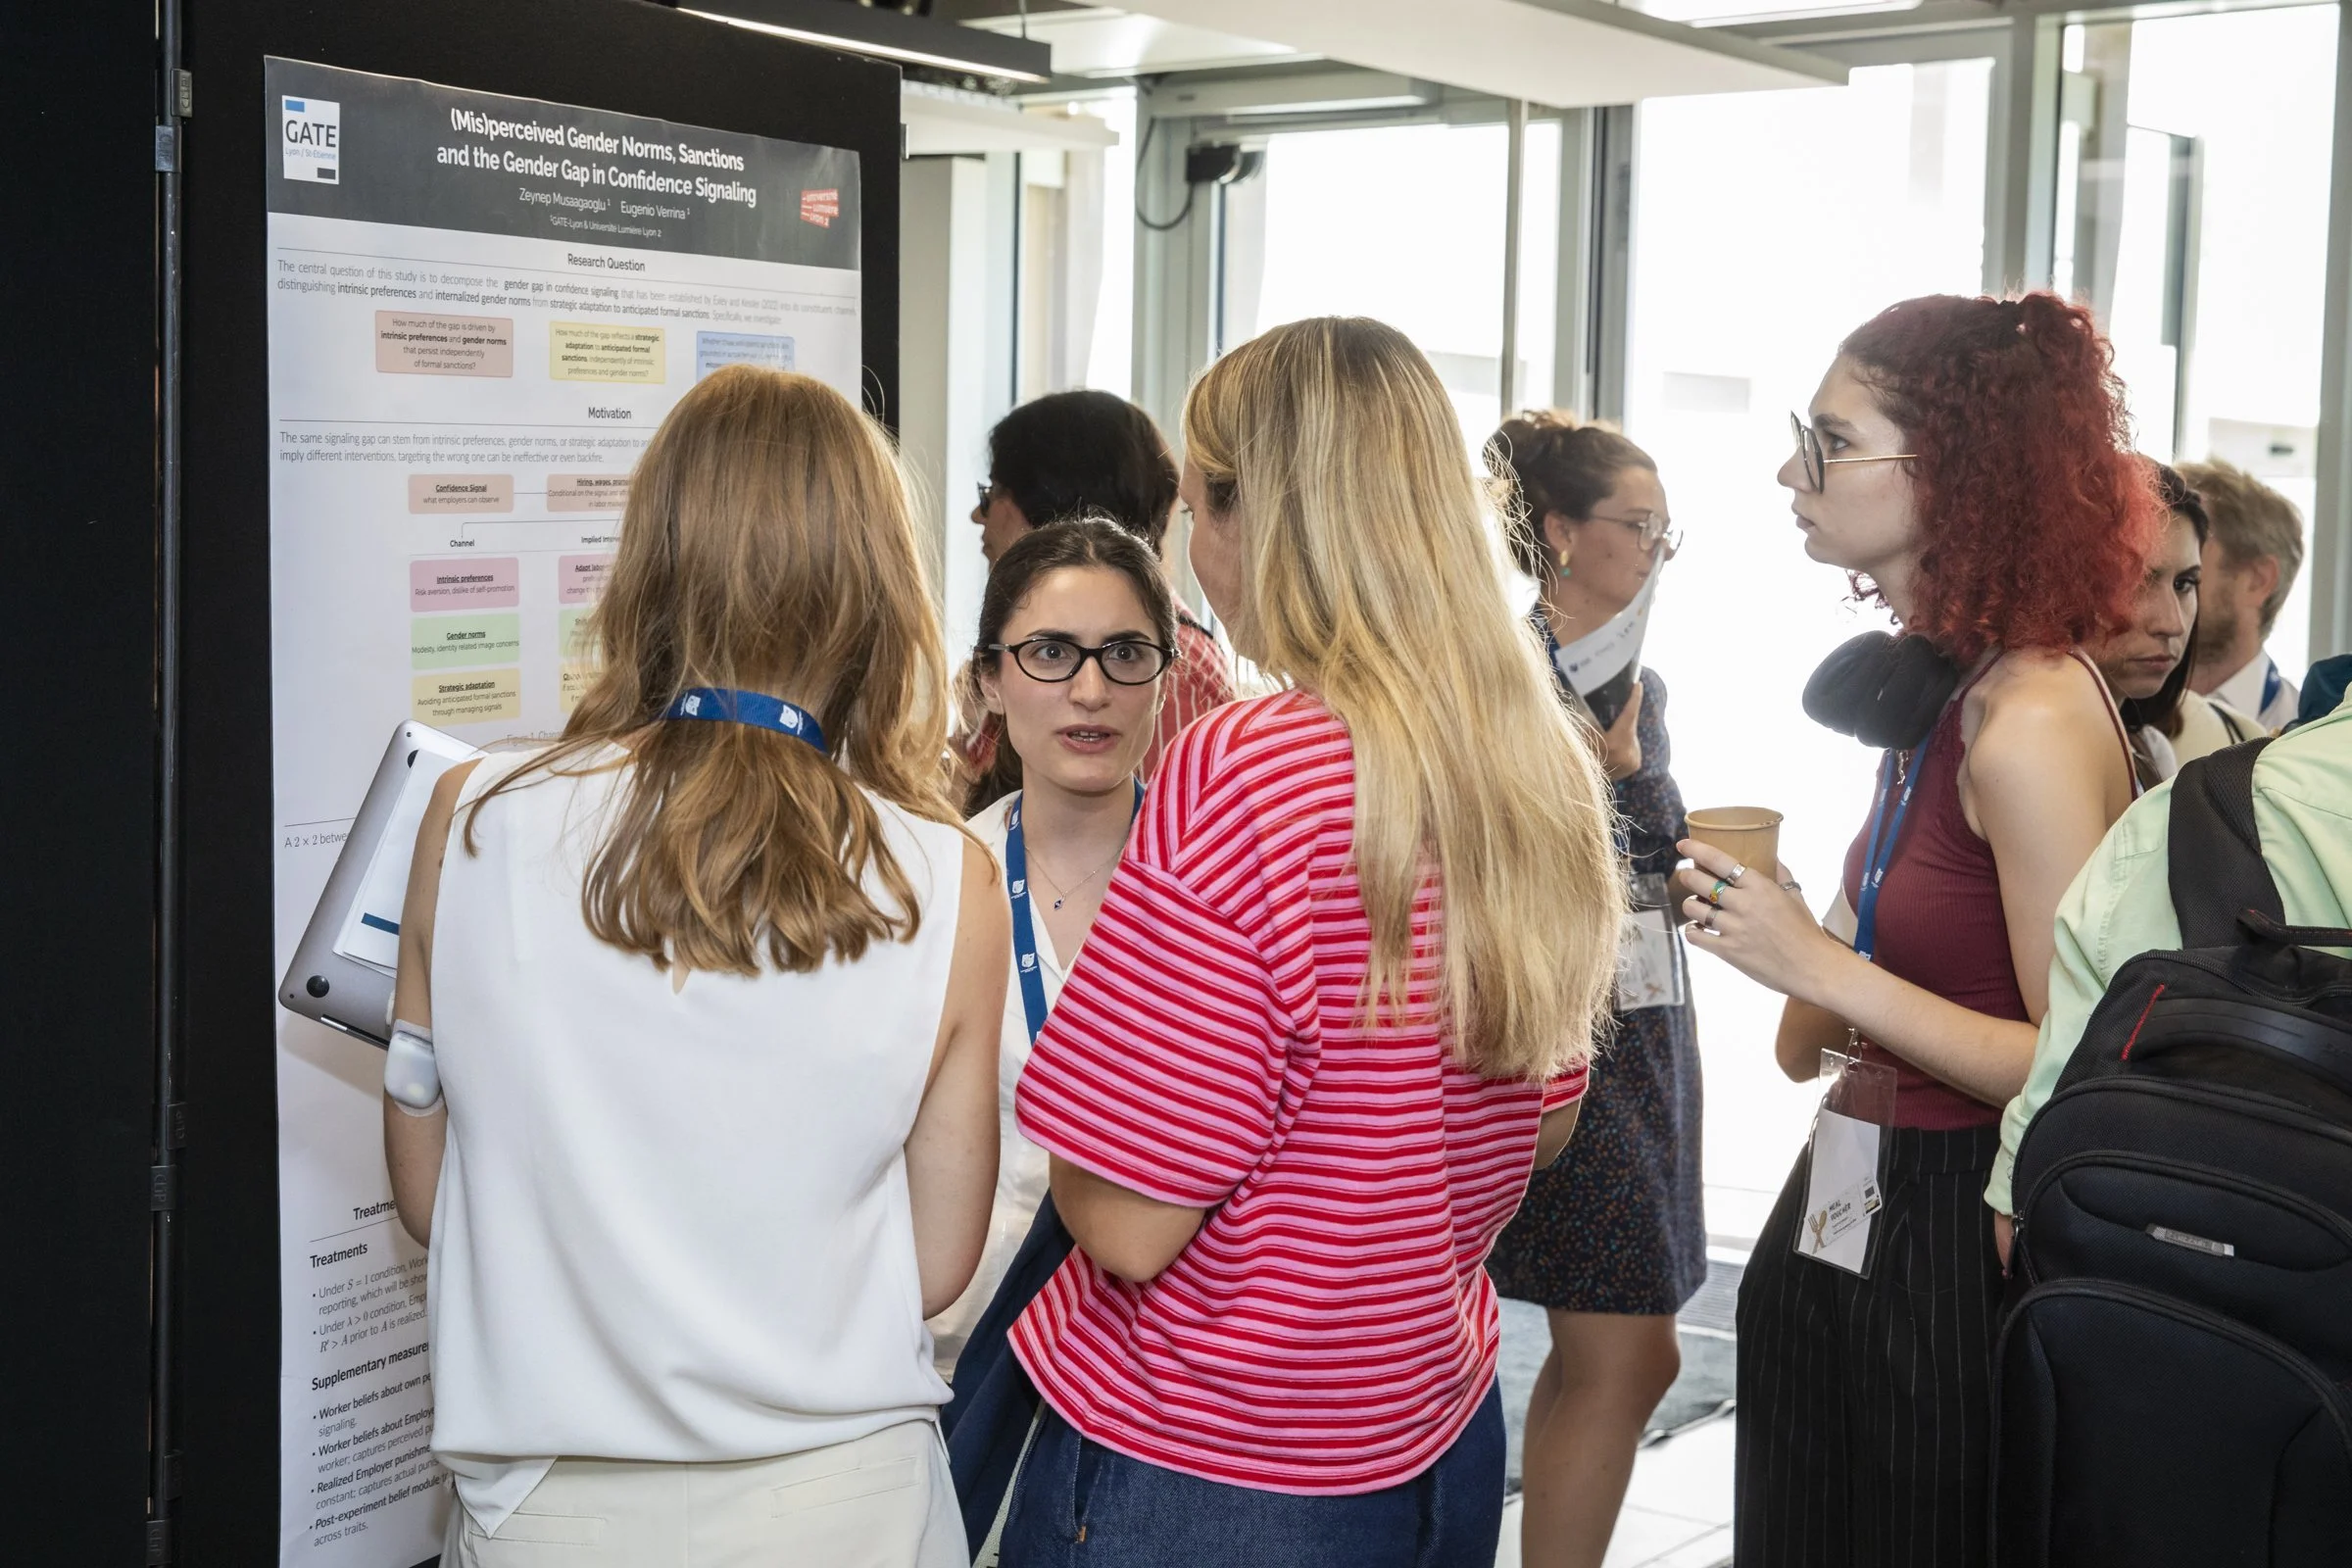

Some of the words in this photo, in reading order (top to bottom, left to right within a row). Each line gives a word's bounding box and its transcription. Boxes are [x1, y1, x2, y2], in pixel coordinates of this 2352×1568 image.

[285, 120, 336, 148] GATE
[451, 108, 564, 145] (Mis)perceived
[567, 126, 617, 154] Gender
[622, 135, 676, 164] Norms,
[679, 144, 744, 171] Sanctions
[437, 145, 469, 167] and
[473, 149, 499, 170] the
[504, 151, 557, 177] Gender
[562, 160, 589, 186] Gap
[593, 164, 605, 184] in
[609, 167, 692, 195] Confidence
[696, 177, 757, 208] Signaling
[519, 188, 551, 206] Zeynep
[621, 201, 655, 218] Eugenio
[656, 206, 685, 220] Verrina
[568, 254, 605, 268] Research
[608, 257, 645, 270] Question
[277, 260, 294, 271] The
[299, 263, 325, 274] central
[330, 265, 364, 277] question
[378, 268, 391, 278] this
[395, 269, 416, 283] study
[441, 271, 482, 287] decompose
[486, 275, 498, 286] the
[505, 277, 528, 290] gender
[532, 281, 543, 293] gap
[277, 278, 335, 296] distinguishing
[338, 283, 368, 295] intrinsic
[370, 286, 416, 299] preferences
[418, 289, 432, 299] and
[435, 289, 479, 303] internalized
[481, 293, 507, 306] gender
[509, 297, 530, 306] norms
[532, 296, 548, 307] from
[551, 299, 577, 312] strategic
[579, 301, 612, 314] adaptation
[622, 304, 659, 317] anticipated
[661, 306, 680, 317] formal
[381, 331, 407, 340] intrinsic
[409, 333, 447, 343] preferences
[463, 336, 484, 345] gender
[418, 347, 438, 356] persist
[440, 348, 484, 359] independently
[589, 407, 631, 418] Motivation
[280, 432, 297, 443] The
[325, 433, 360, 446] signaling
[362, 436, 375, 447] gap
[393, 434, 411, 444] stem
[413, 434, 430, 444] from
[432, 434, 461, 444] intrinsic
[509, 437, 533, 448] gender
[569, 438, 596, 449] strategic
[598, 438, 631, 449] adaptation
[280, 451, 304, 463] imply
[307, 451, 342, 461] different
[398, 451, 430, 464] targeting
[433, 451, 444, 461] the
[447, 454, 468, 464] wrong
[514, 452, 549, 462] ineffective
[436, 484, 468, 493] Confidence
[470, 484, 487, 493] Signal
[437, 575, 460, 584] Intrinsic
[476, 585, 514, 594] self-promotion
[447, 631, 466, 640] Gender
[437, 644, 457, 653] identity
[439, 683, 464, 693] Strategic
[466, 681, 495, 691] adaptation
[417, 697, 441, 706] Avoiding
[443, 694, 472, 704] anticipated
[433, 707, 454, 715] through
[456, 706, 483, 714] managing
[484, 704, 502, 712] signals
[285, 837, 292, 848] A
[294, 837, 299, 847] 2
[312, 835, 317, 845] 2
[353, 1200, 395, 1220] Treatme
[310, 1243, 368, 1268] Treatments
[318, 1283, 345, 1298] Under
[348, 1279, 353, 1290] S
[365, 1275, 368, 1285] 1
[370, 1264, 407, 1283] condition,
[319, 1294, 359, 1317] reporting,
[360, 1287, 382, 1302] which
[385, 1280, 397, 1293] will
[399, 1278, 409, 1290] be
[370, 1298, 406, 1319] condition,
[350, 1330, 367, 1344] prior
[370, 1327, 378, 1336] to
[312, 1356, 386, 1391] Supplementary
[388, 1342, 428, 1365] measure
[319, 1402, 351, 1419] Worker
[353, 1391, 378, 1408] beliefs
[381, 1383, 402, 1399] about
[405, 1376, 420, 1390] own
[318, 1417, 357, 1438] signaling.
[318, 1439, 351, 1456] Worker
[353, 1427, 378, 1446] beliefs
[380, 1419, 404, 1435] about
[352, 1442, 385, 1462] captures
[388, 1426, 423, 1449] perceived
[318, 1473, 353, 1494] Realized
[356, 1459, 393, 1480] Employer
[395, 1445, 430, 1468] punishme
[358, 1476, 392, 1495] captures
[394, 1465, 416, 1483] actual
[316, 1497, 386, 1530] Post-experiment
[389, 1486, 411, 1504] belief
[412, 1475, 439, 1494] module
[314, 1530, 341, 1546] across
[345, 1521, 368, 1536] traits.
